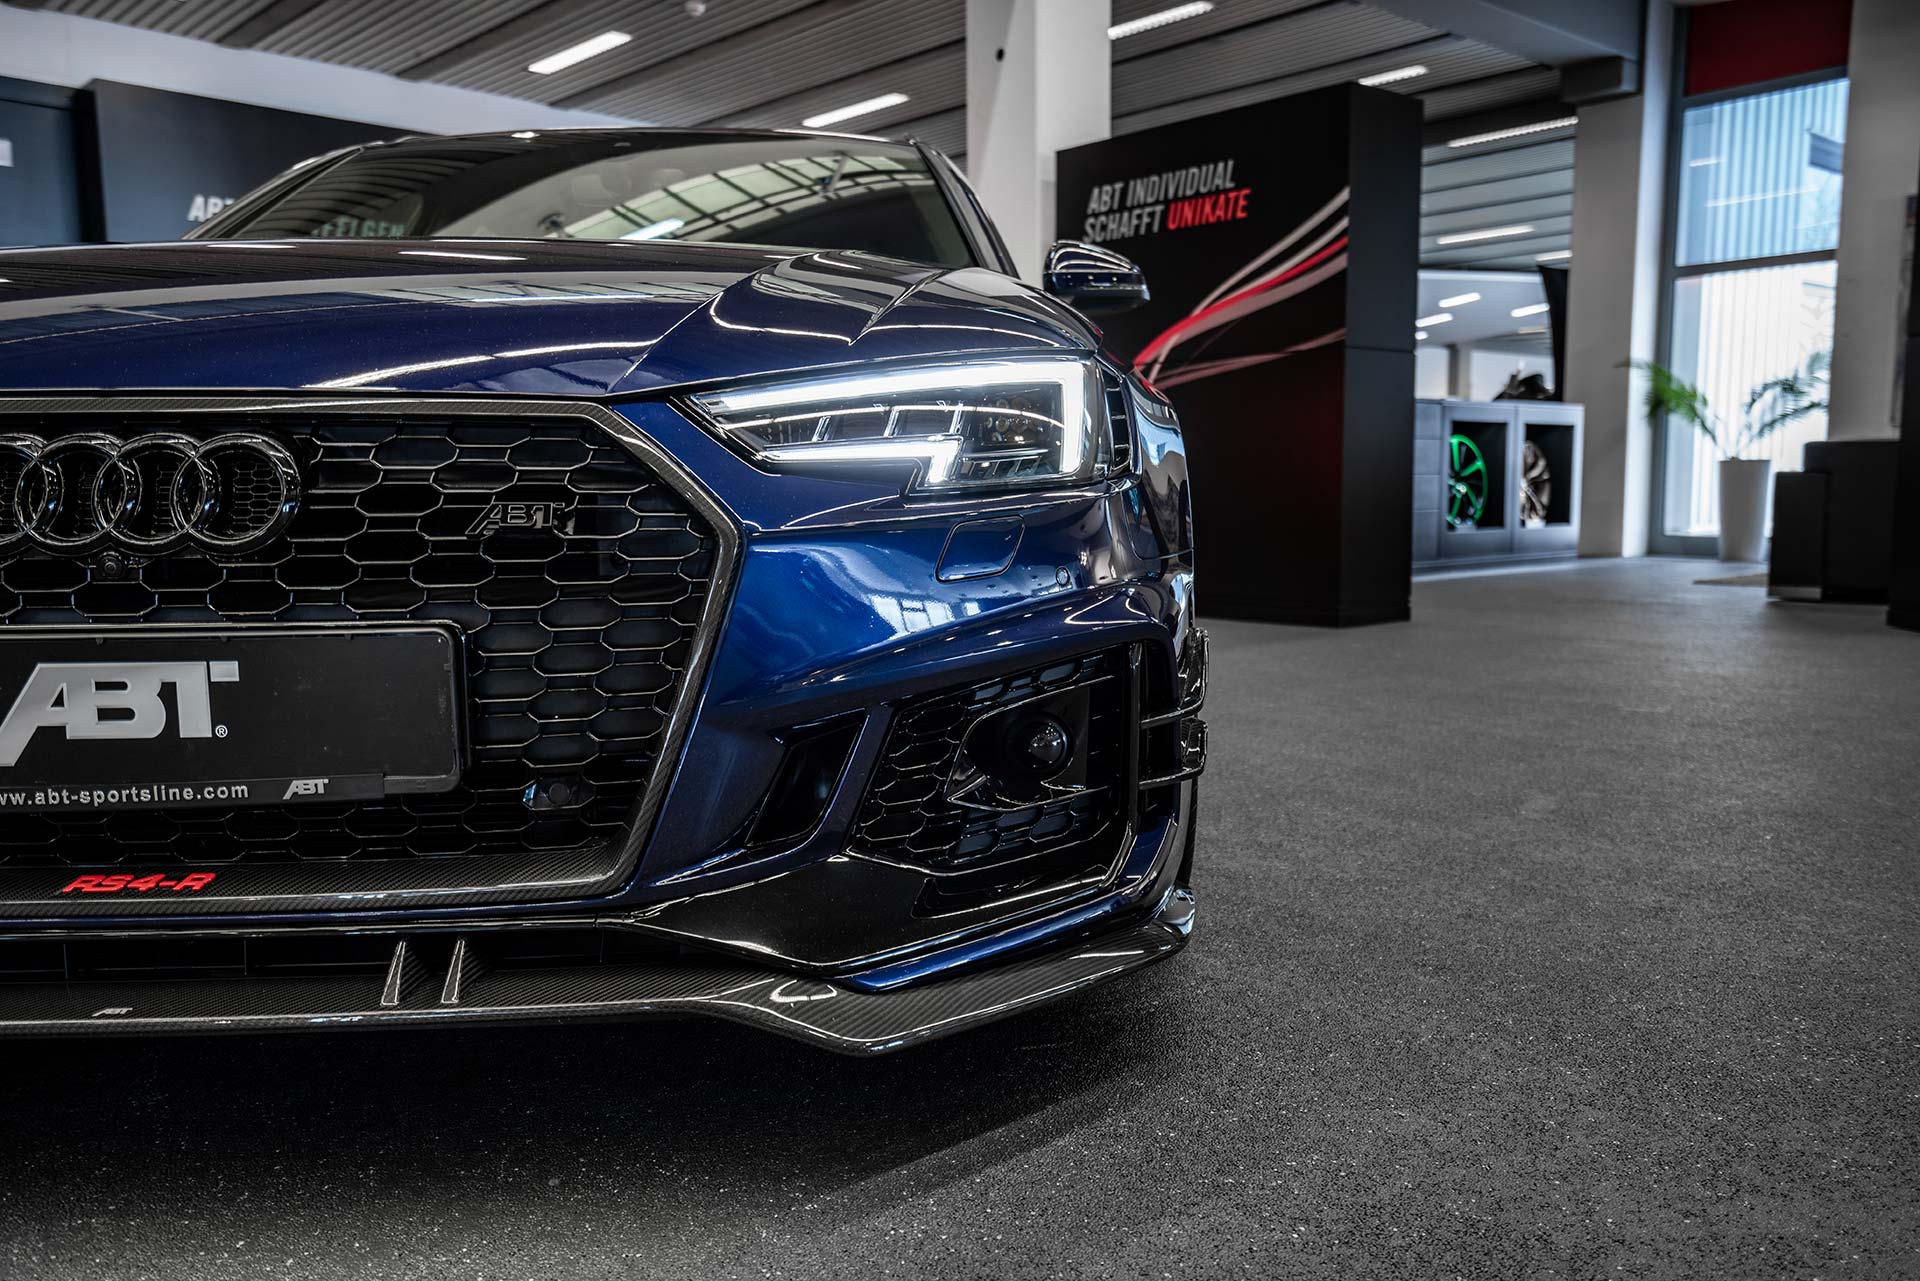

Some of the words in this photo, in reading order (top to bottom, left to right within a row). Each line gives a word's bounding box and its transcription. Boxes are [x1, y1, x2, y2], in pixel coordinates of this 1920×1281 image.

[1087, 181, 1124, 216] ABT
[1125, 158, 1236, 208] INDIVIDUAL
[1083, 204, 1165, 244] SCHAFFT
[1167, 186, 1251, 231] UNIKATE
[464, 502, 565, 535] ABT
[283, 778, 330, 800] ABT
[62, 872, 217, 894] RS4-R
